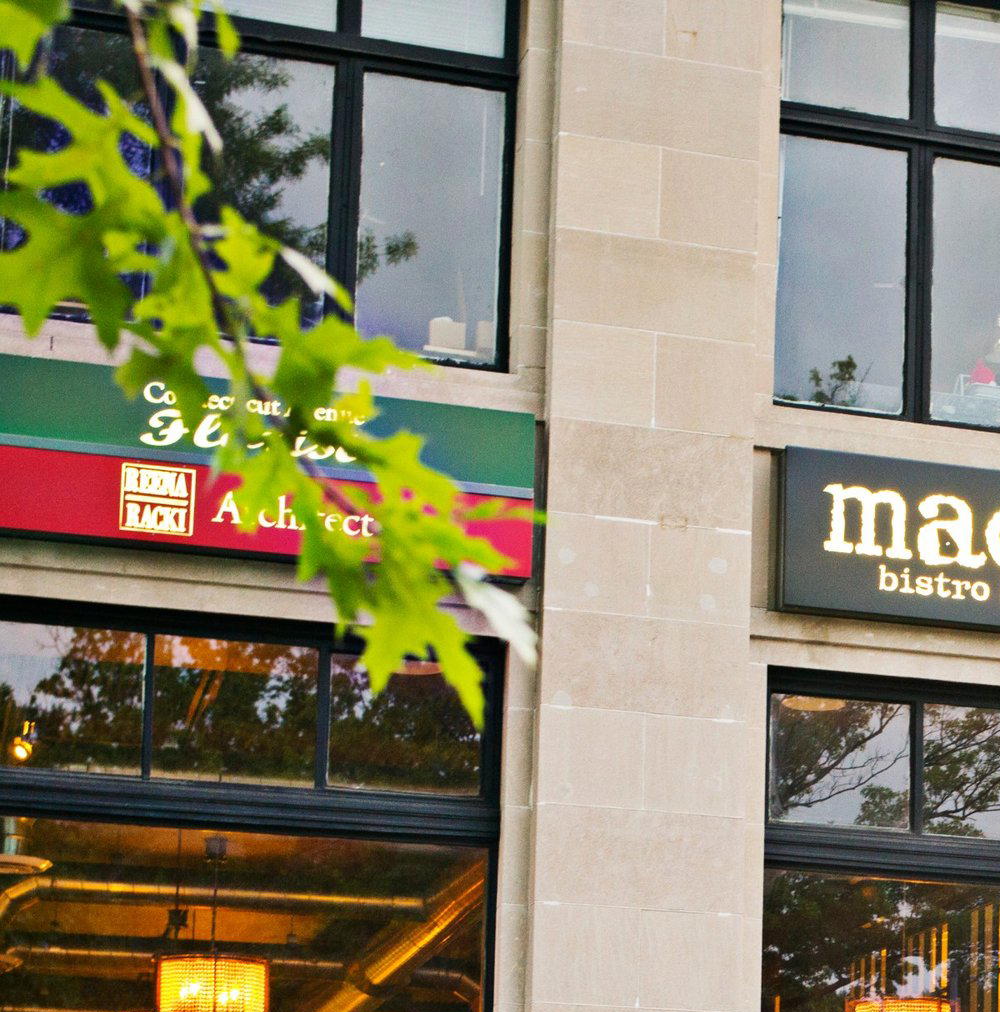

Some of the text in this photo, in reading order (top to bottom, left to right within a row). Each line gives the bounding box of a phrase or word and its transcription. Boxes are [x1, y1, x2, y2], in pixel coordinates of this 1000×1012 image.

[143, 381, 282, 416] Coeccut
[140, 408, 357, 463] Flis
[125, 467, 189, 499] REENA
[211, 490, 375, 538] Achect
[878, 565, 991, 603] bistro
